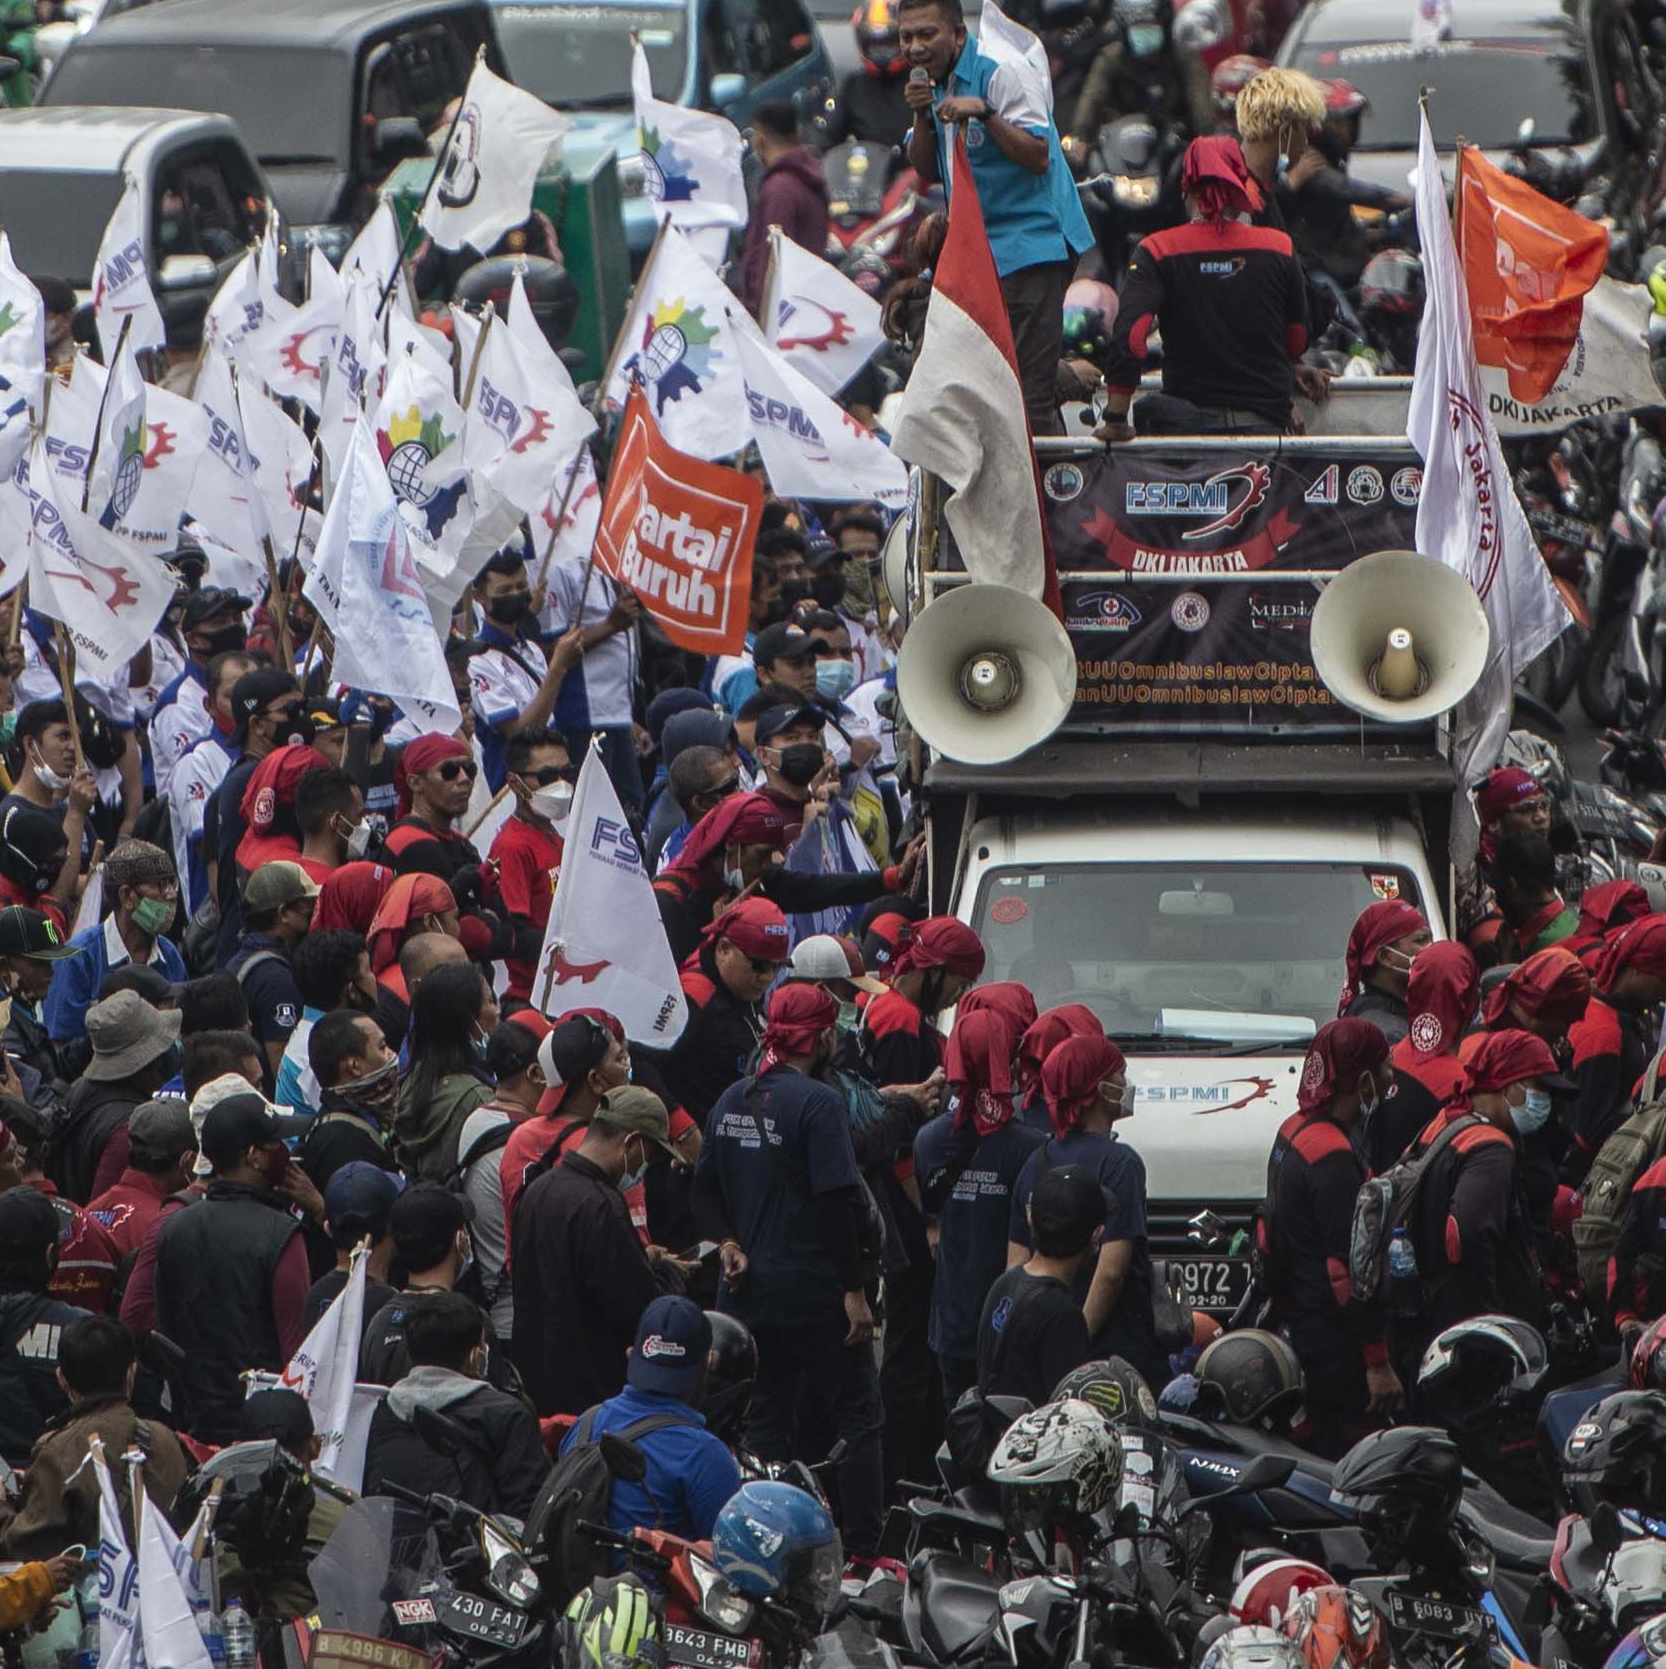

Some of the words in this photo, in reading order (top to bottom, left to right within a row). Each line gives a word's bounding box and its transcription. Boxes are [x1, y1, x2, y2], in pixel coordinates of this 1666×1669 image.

[1489, 393, 1519, 419] DKI
[1519, 394, 1622, 425] JAKARTA
[1126, 482, 1228, 509] FSPMI
[1464, 442, 1496, 552] Jakarta
[1132, 549, 1164, 572] DKI
[619, 528, 717, 617] Buruh
[1190, 1457, 1241, 1477] NMAX
[396, 1602, 433, 1618] NGK
[1393, 1594, 1404, 1611] B
[489, 1606, 526, 1630] FAT
[713, 1637, 748, 1659] FMB
